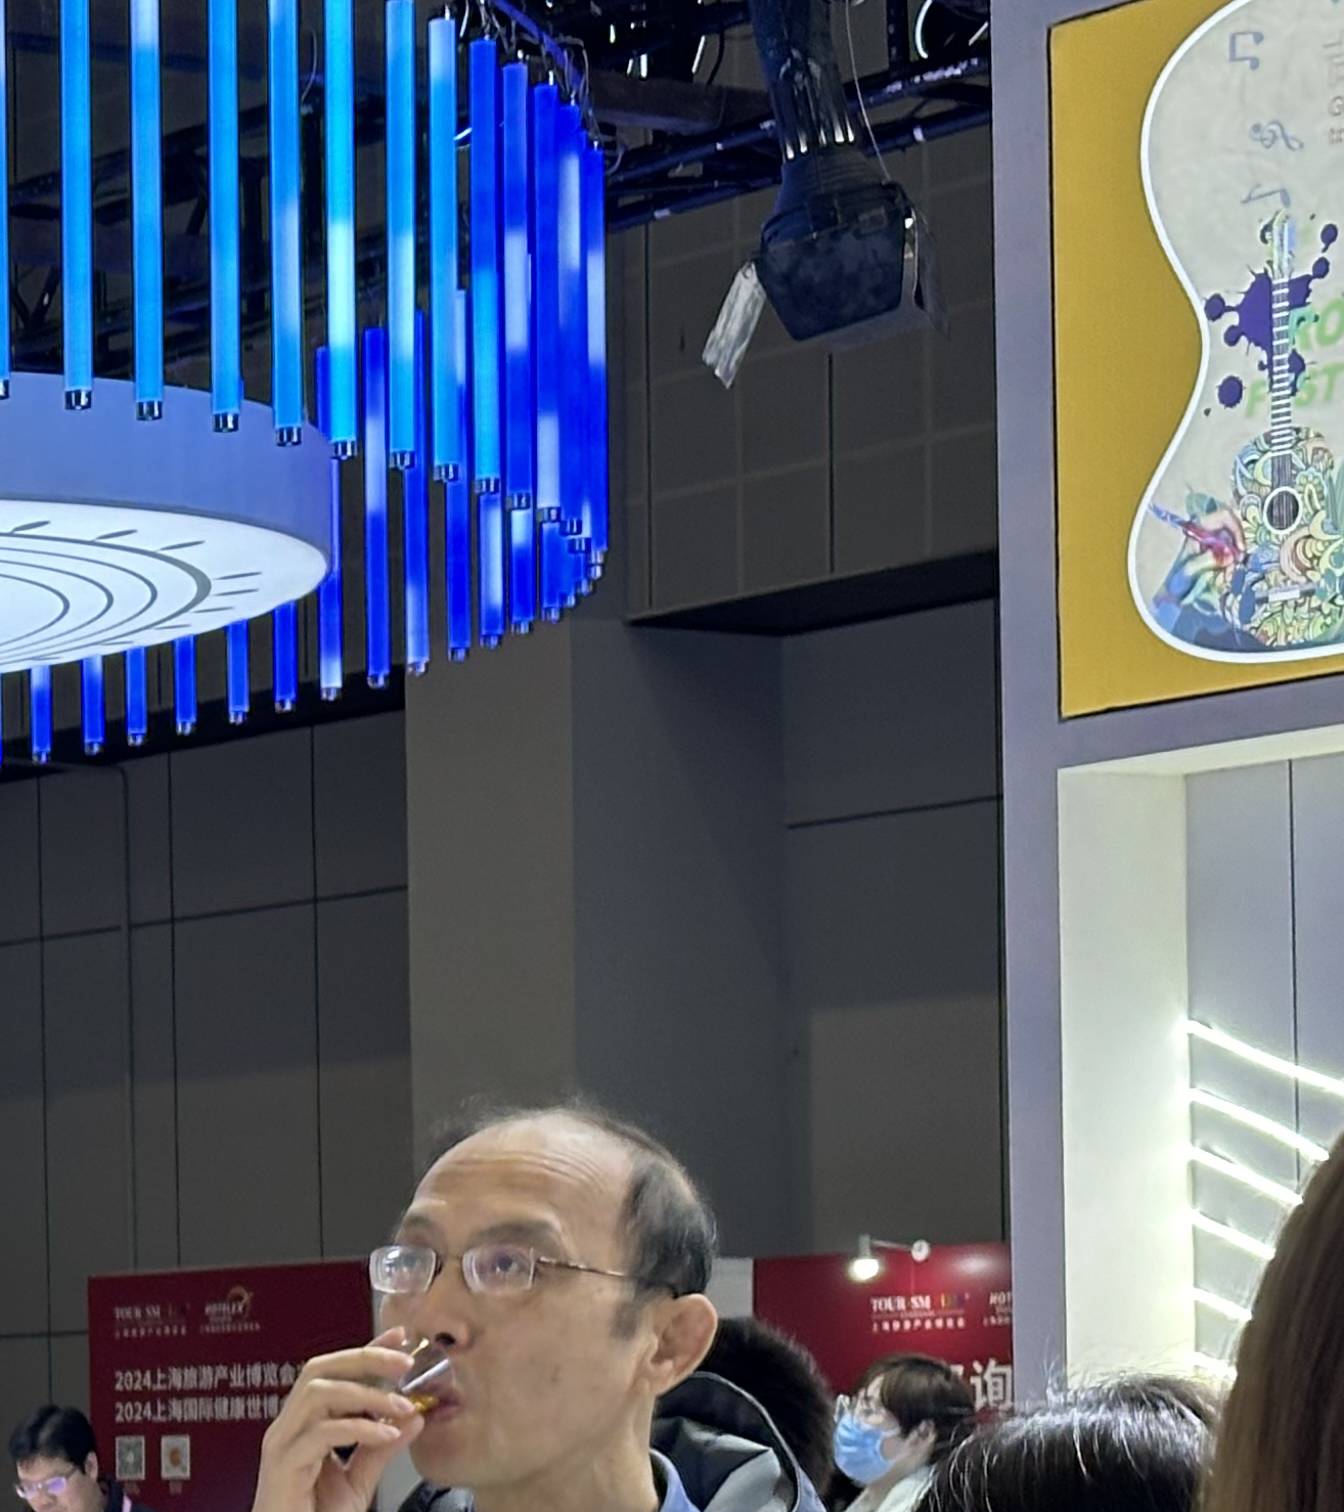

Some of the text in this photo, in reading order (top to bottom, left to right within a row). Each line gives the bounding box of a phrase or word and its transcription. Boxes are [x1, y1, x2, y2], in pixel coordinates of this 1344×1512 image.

[114, 1361, 304, 1392] 2024上海旅游产业博览会
[114, 1394, 286, 1424] 2024上海国际健康世博
